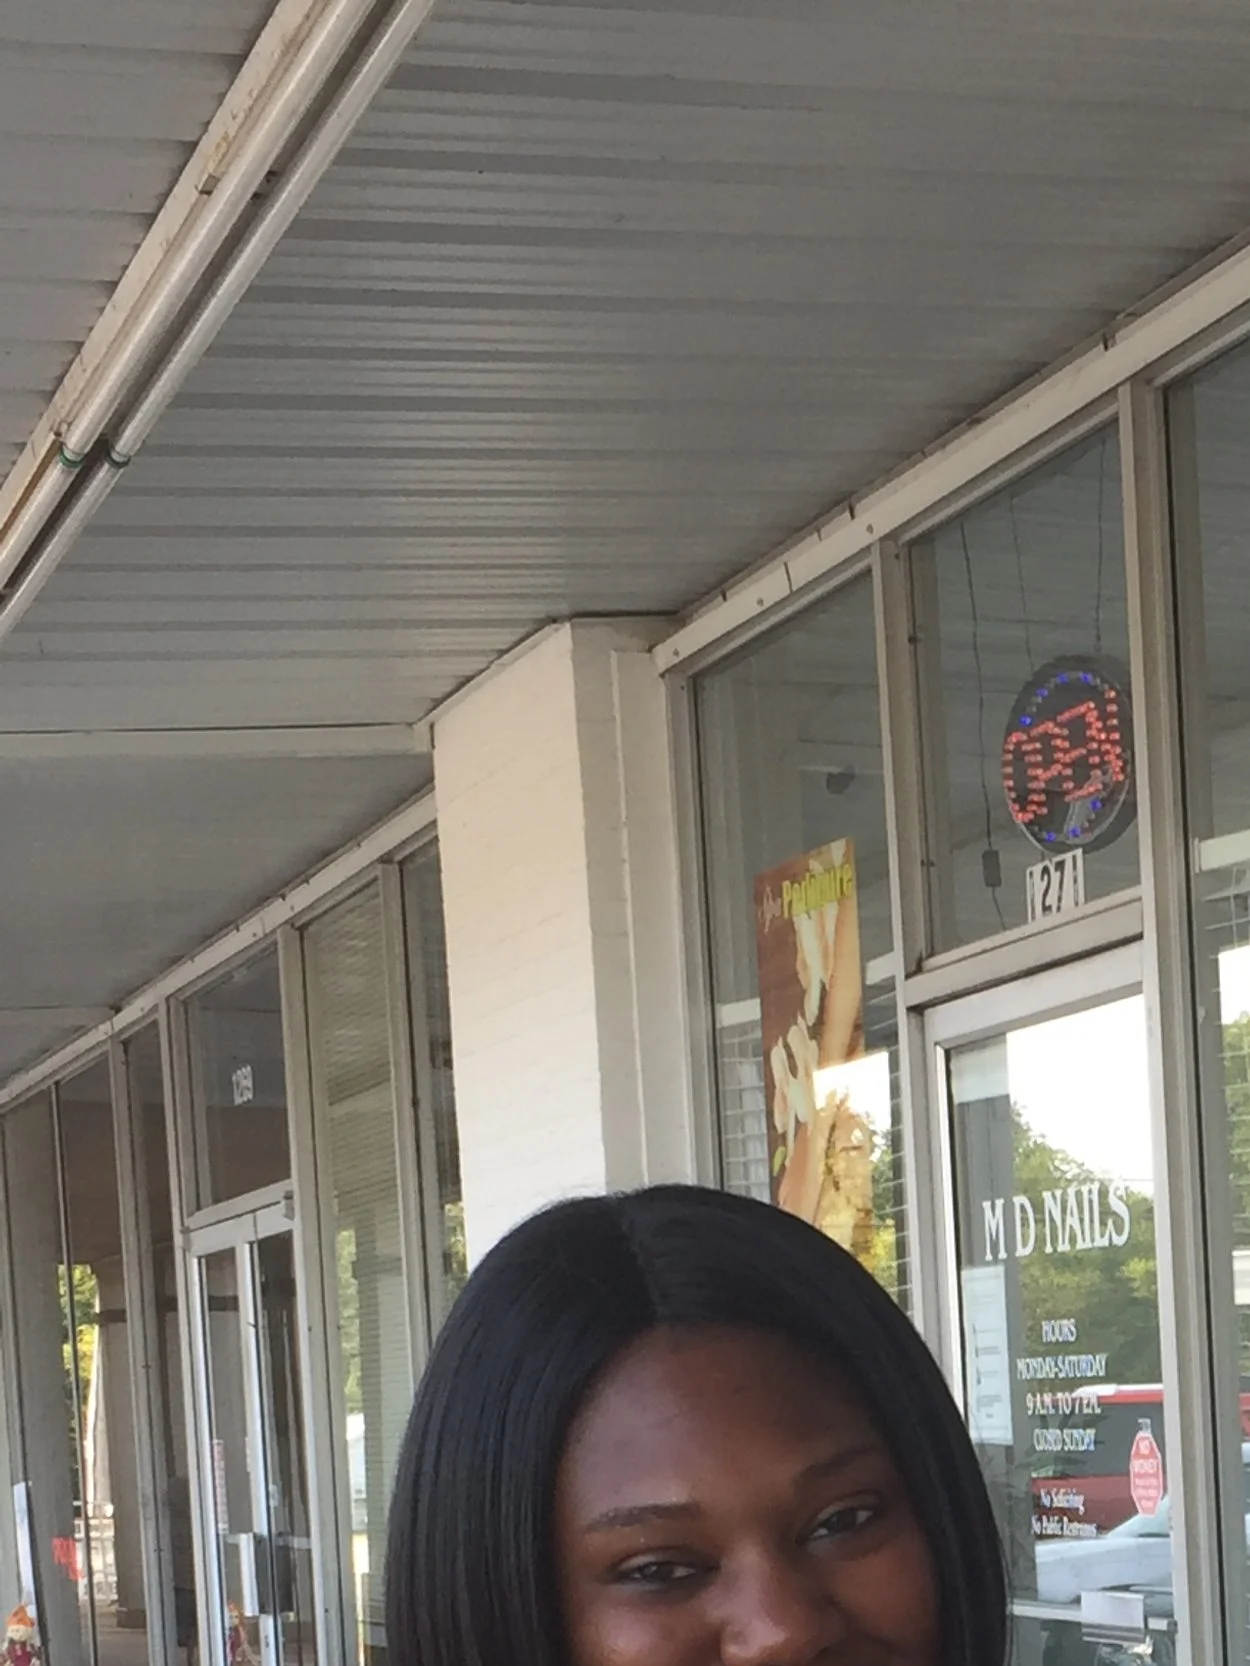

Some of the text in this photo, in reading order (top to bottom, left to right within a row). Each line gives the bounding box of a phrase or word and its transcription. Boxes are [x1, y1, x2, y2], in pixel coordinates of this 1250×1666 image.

[1003, 689, 1127, 823] OPEN
[1028, 853, 1080, 921] 1271
[982, 1177, 1131, 1262] M D NAILS
[1041, 1318, 1078, 1343] HOURS
[1016, 1352, 1109, 1380] MONDAY-SATURDAY
[1026, 1393, 1034, 1416] 9
[1056, 1391, 1072, 1415] TO
[1040, 1488, 1051, 1508] No
